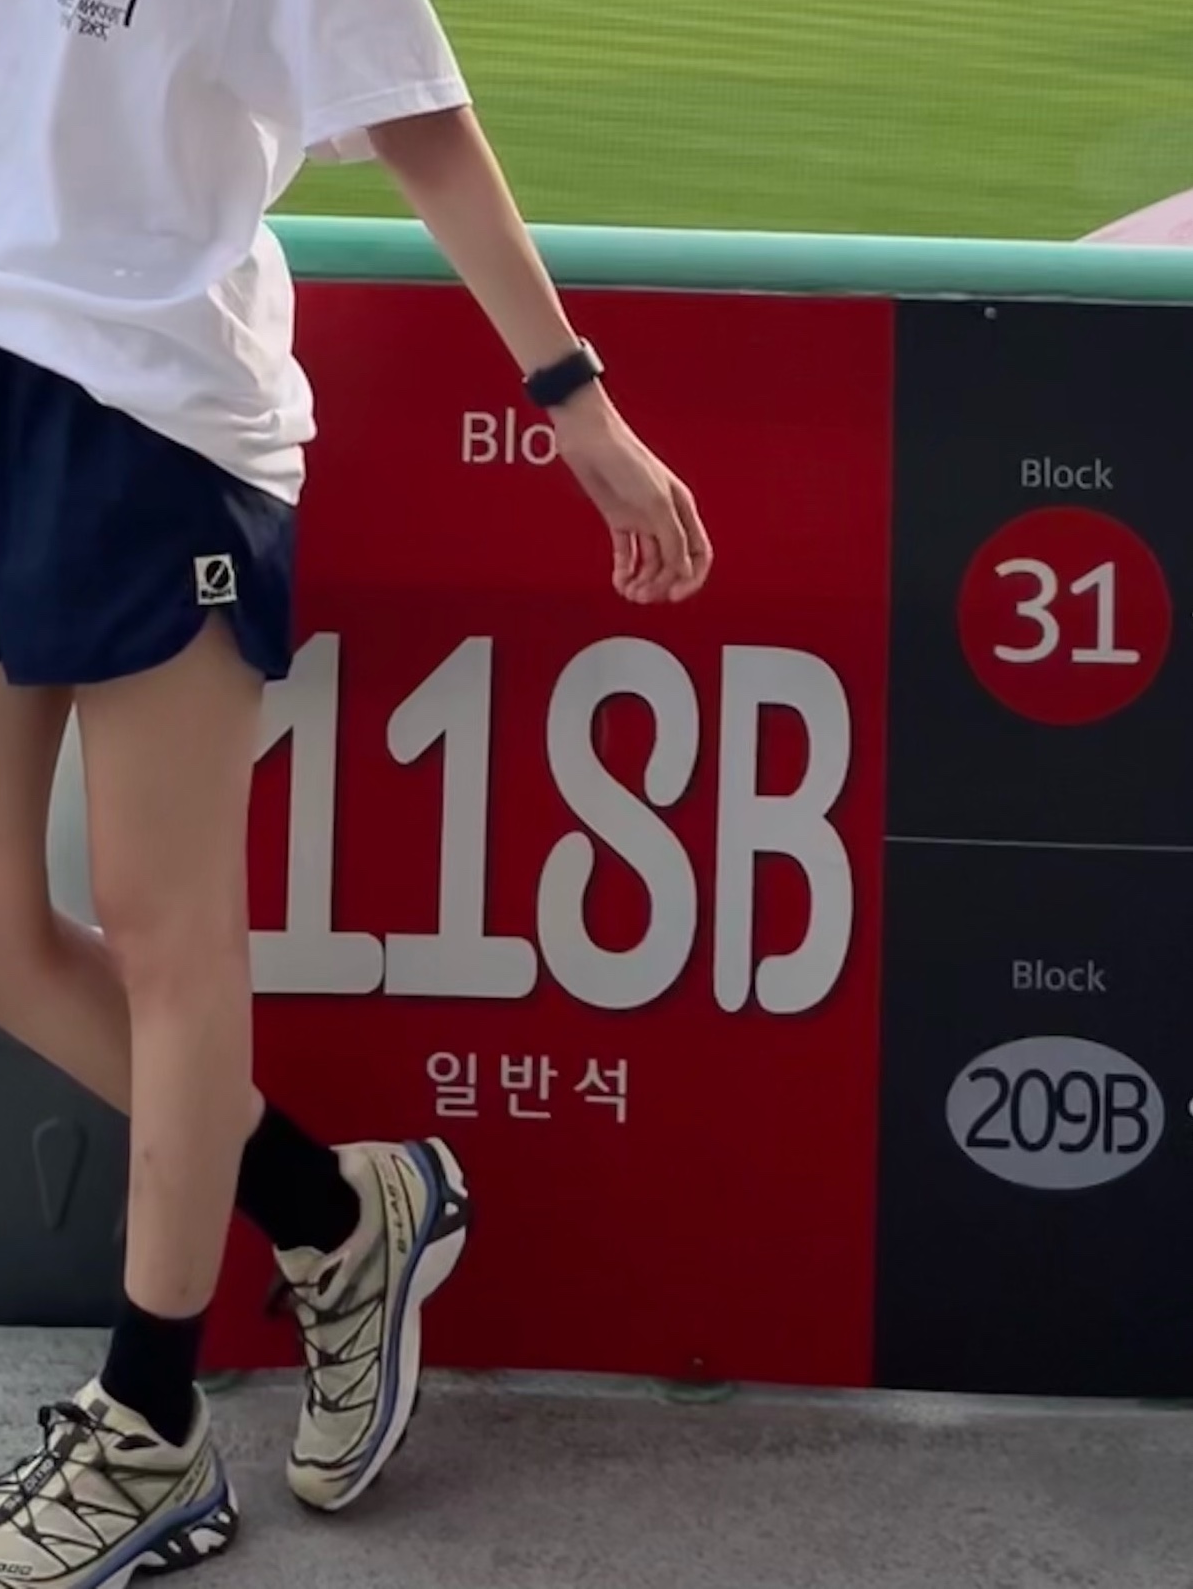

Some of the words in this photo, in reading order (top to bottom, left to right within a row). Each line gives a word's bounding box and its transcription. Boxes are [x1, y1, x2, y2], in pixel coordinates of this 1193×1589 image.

[462, 406, 557, 465] Blo
[1021, 457, 1113, 489] Block
[993, 558, 1141, 664] 31
[1012, 960, 1106, 991] Block
[425, 1051, 629, 1123] 일반석
[965, 1067, 1149, 1154] 209B
